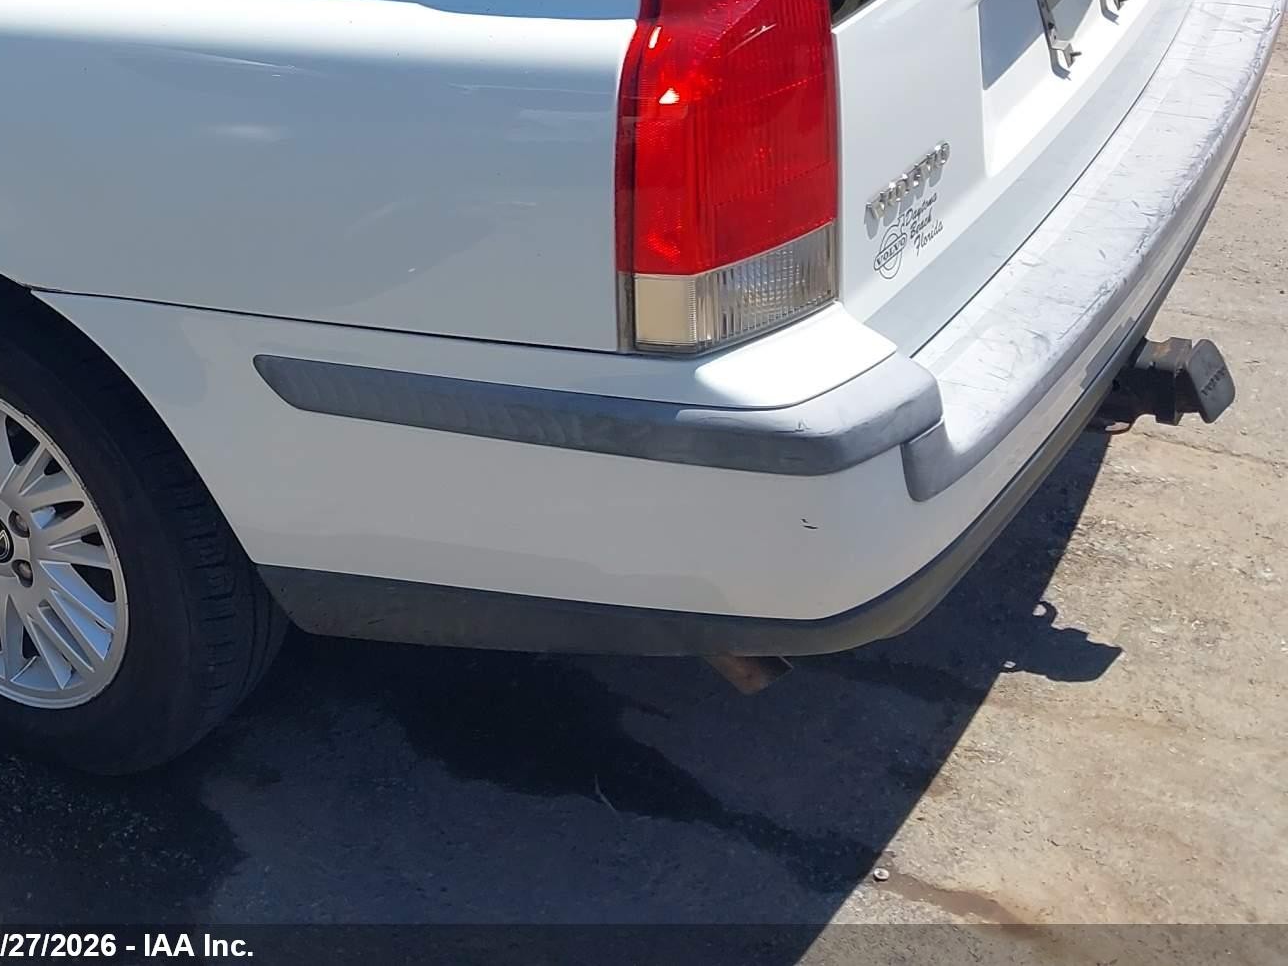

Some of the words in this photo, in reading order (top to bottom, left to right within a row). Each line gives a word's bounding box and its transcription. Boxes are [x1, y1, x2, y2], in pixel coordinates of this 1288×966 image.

[904, 192, 938, 226] Daytona
[910, 208, 933, 238] Beach
[876, 237, 906, 265] VOLVO
[914, 220, 944, 256] Florida
